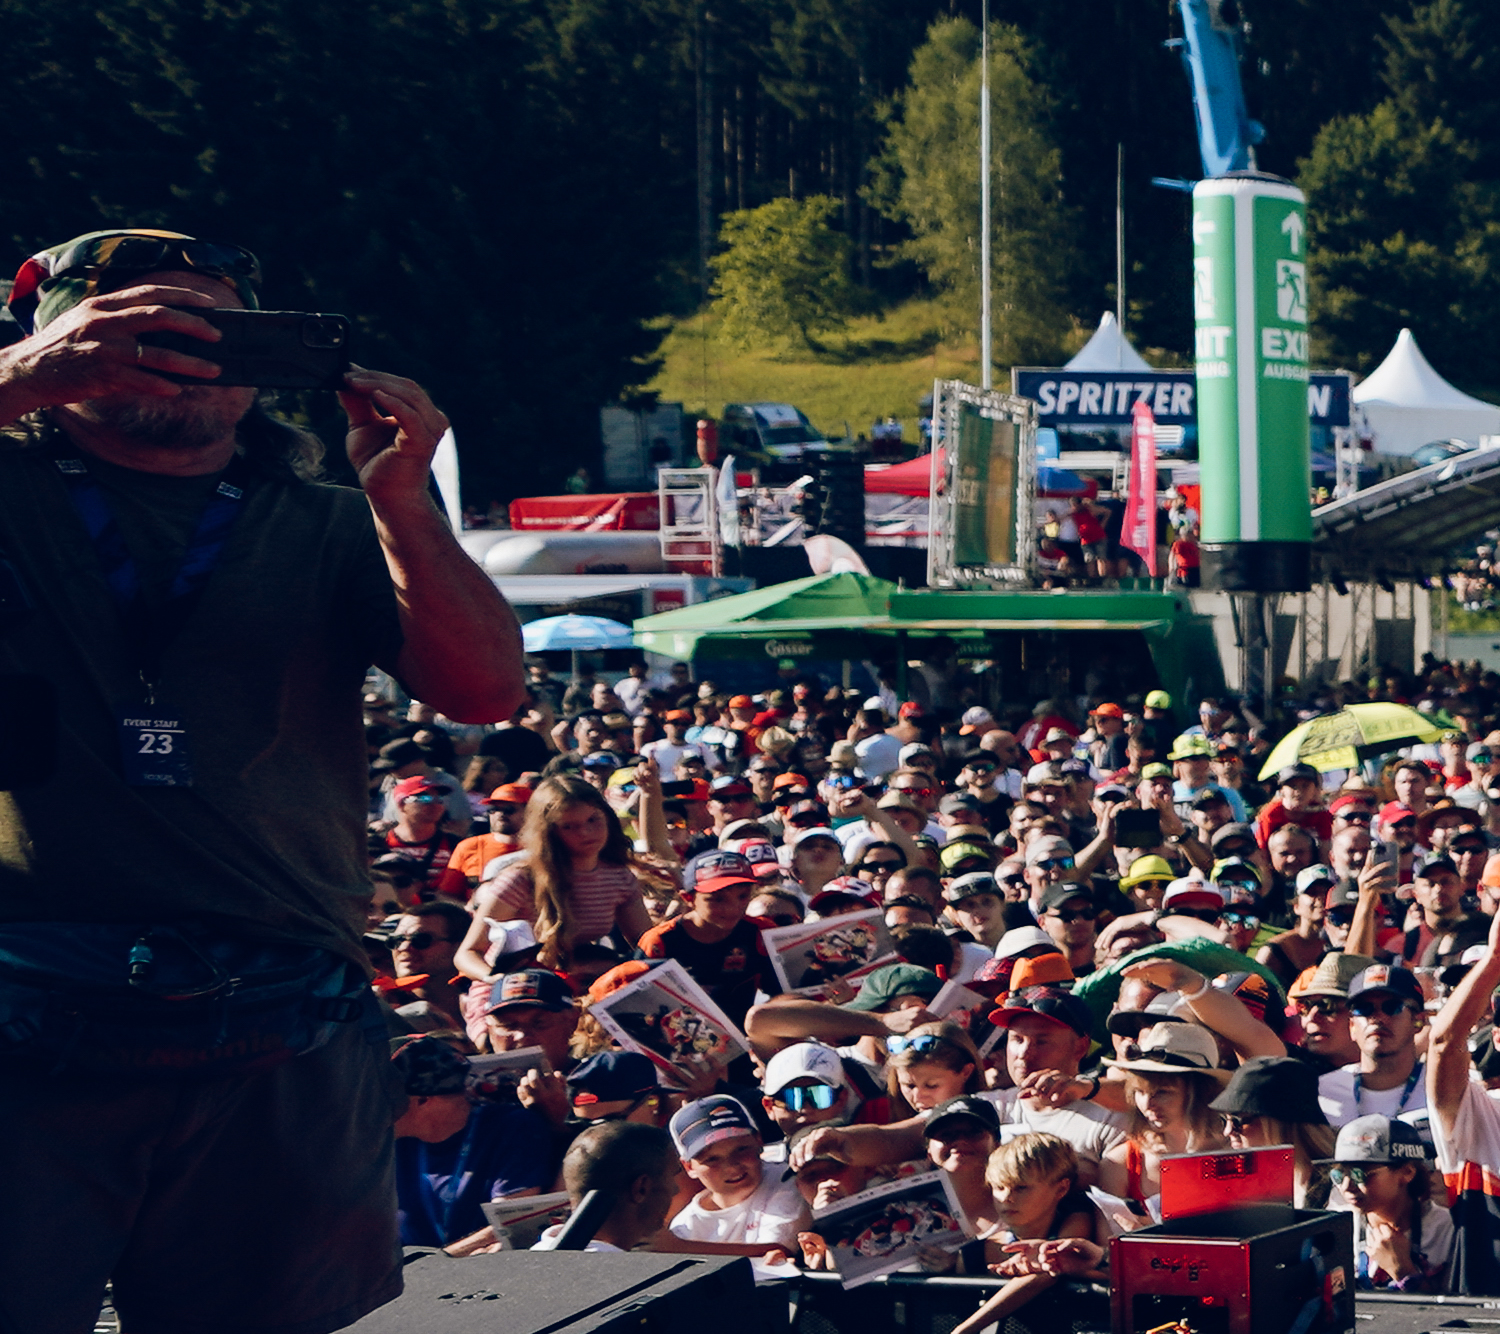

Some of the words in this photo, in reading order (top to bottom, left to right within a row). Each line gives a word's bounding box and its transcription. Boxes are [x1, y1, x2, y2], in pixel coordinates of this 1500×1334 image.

[1262, 327, 1310, 361] EXI
[1038, 380, 1194, 417] SPRITZER
[123, 718, 152, 728] EVENT
[153, 719, 179, 728] STAFF
[138, 733, 173, 755] 23
